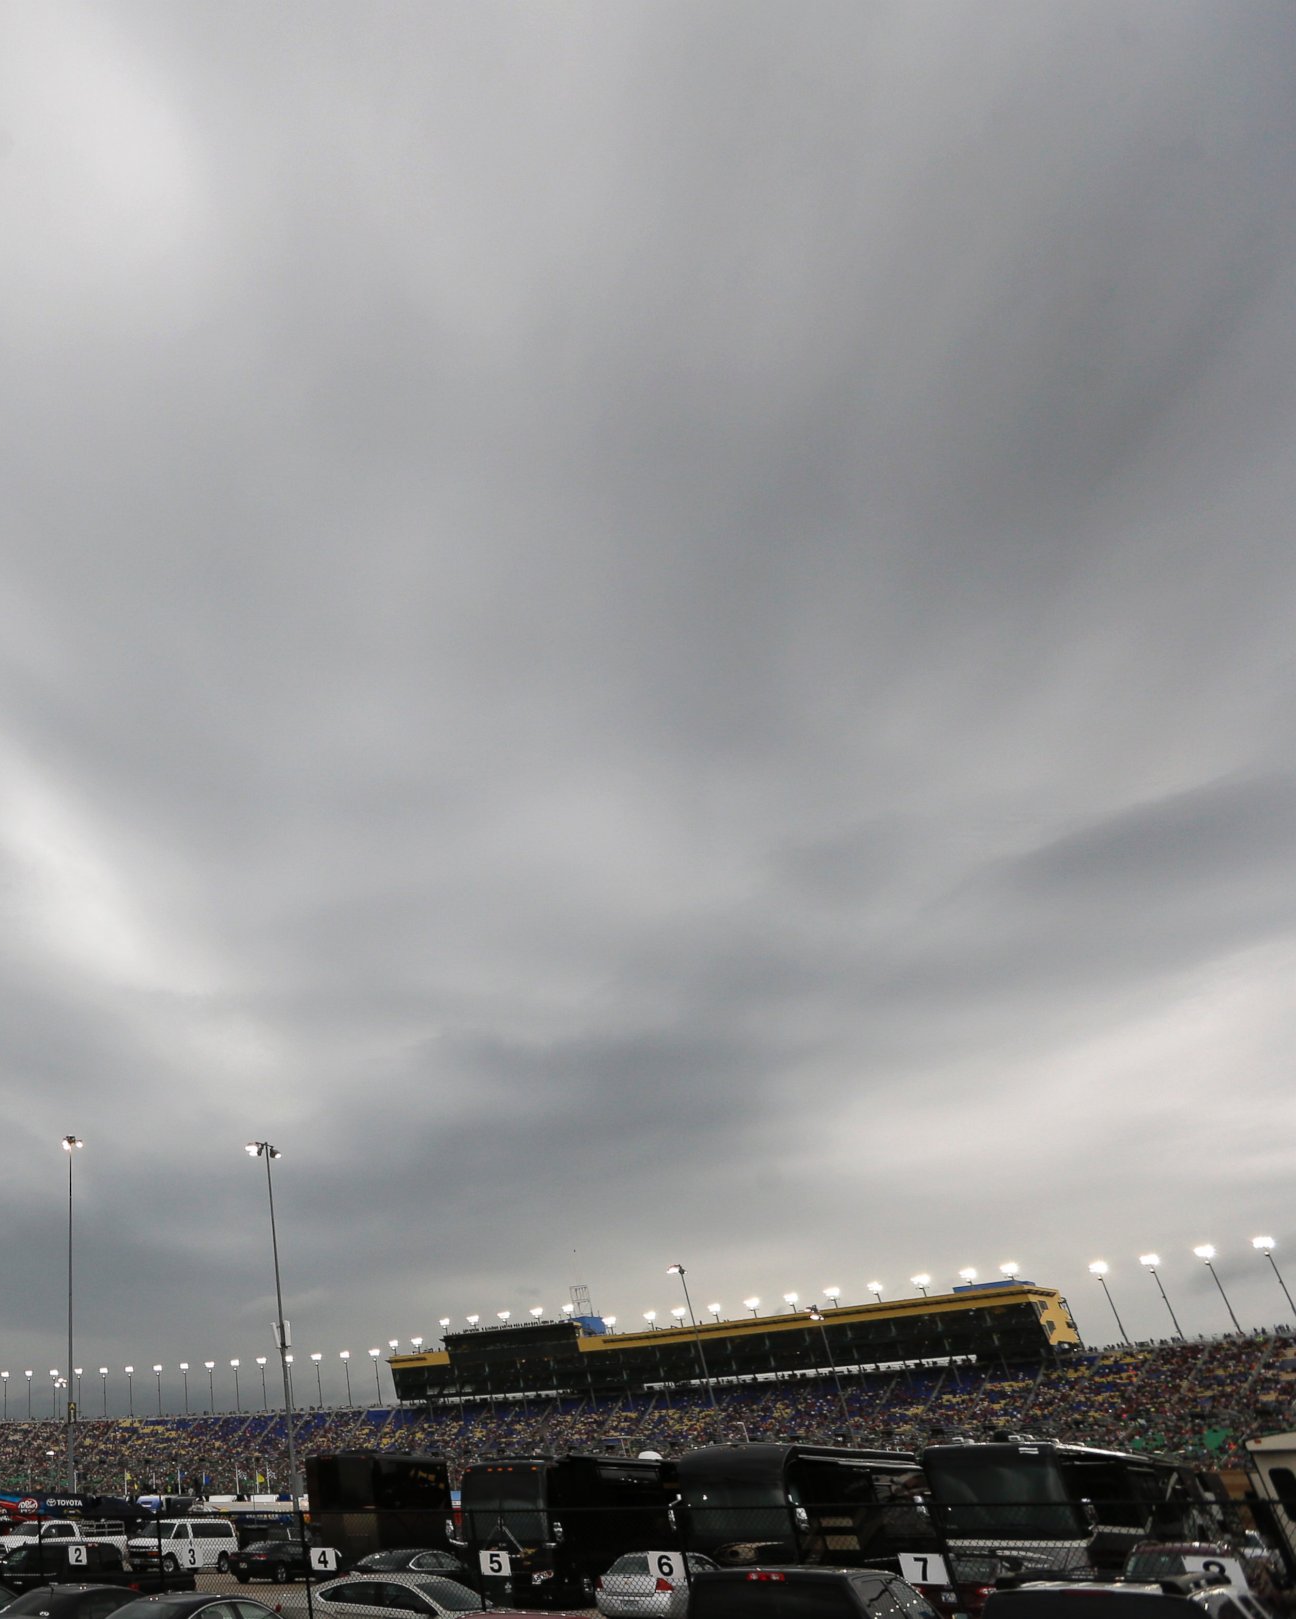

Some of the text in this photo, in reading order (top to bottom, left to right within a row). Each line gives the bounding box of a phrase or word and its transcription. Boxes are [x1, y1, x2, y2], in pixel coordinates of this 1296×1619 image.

[57, 1499, 83, 1507] TOYOTA
[74, 1548, 82, 1563] 2
[188, 1549, 196, 1565] 3
[317, 1551, 329, 1568] 4
[488, 1554, 503, 1573] 5
[657, 1555, 674, 1576] 6
[912, 1557, 929, 1581] 7
